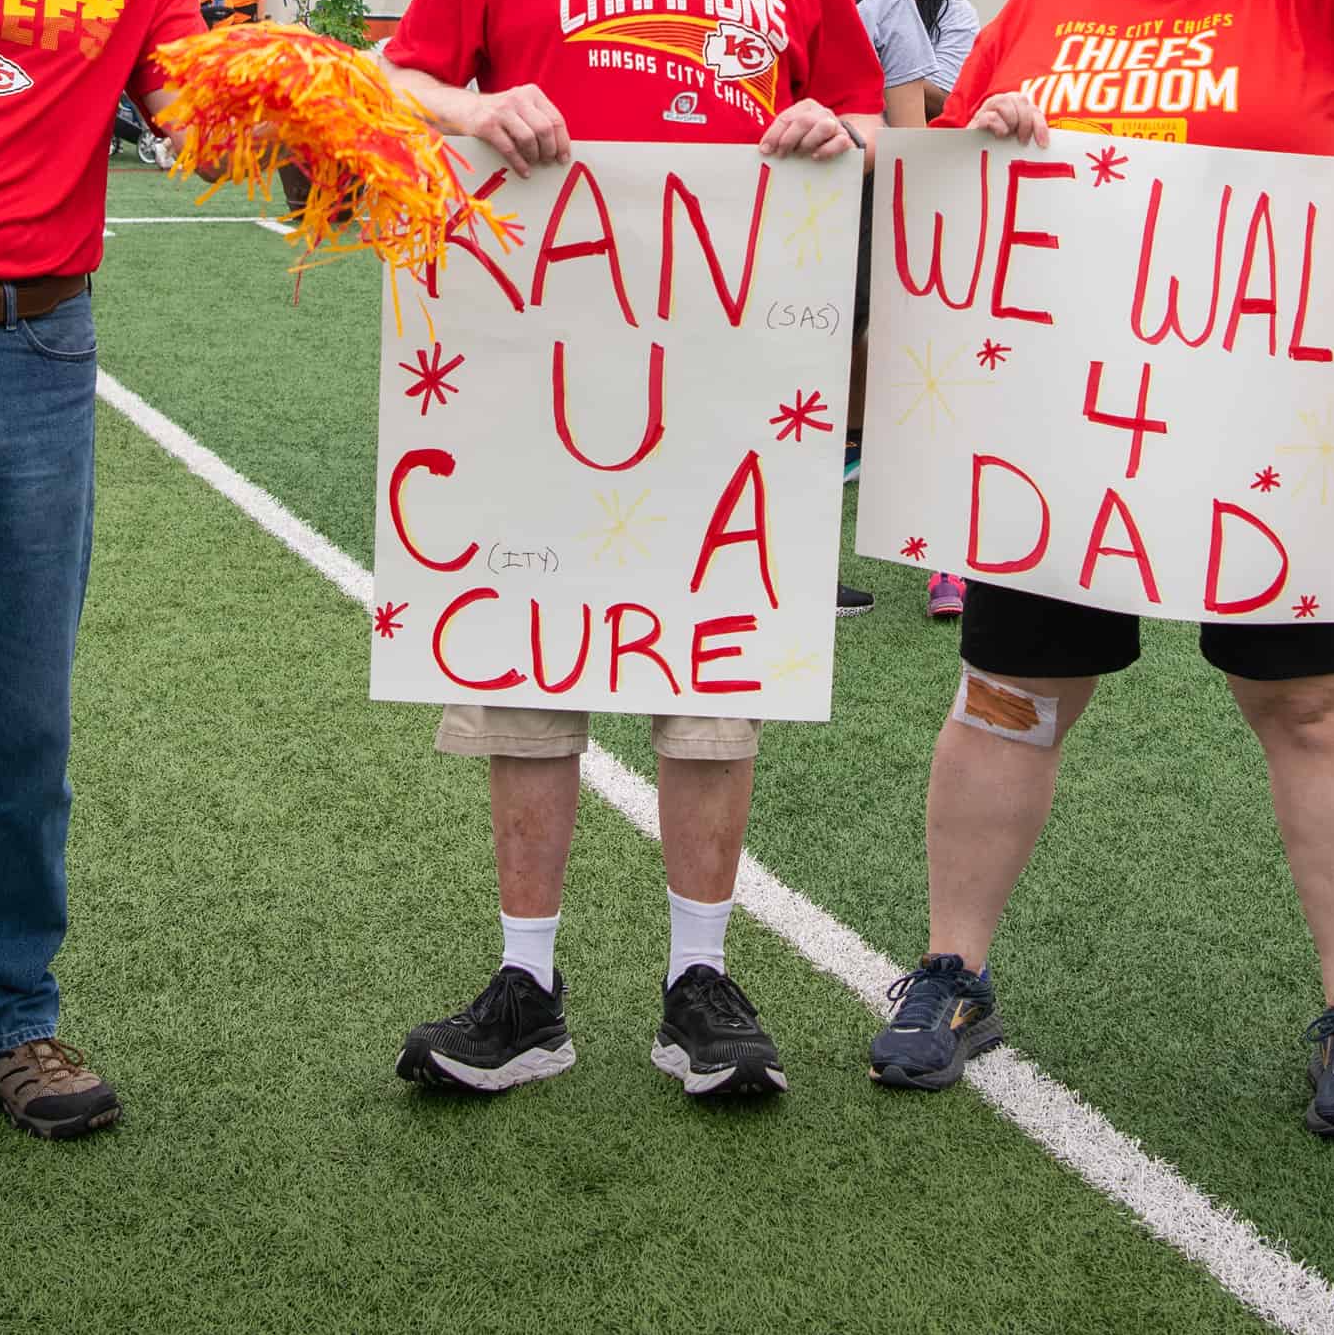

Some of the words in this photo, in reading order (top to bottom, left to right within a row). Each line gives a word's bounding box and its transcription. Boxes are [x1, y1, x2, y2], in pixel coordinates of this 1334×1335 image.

[724, 35, 766, 70] KC
[1051, 29, 1218, 72] CHIEFS
[1055, 21, 1117, 37] KANSAS
[1126, 20, 1164, 38] CITY
[1173, 13, 1234, 34] CHIEFS
[589, 49, 657, 74] KANSAS
[667, 62, 706, 88] CITY
[714, 80, 766, 126] CHIEFS
[1020, 66, 1239, 114] KINGDOM
[891, 149, 1076, 325] WE
[552, 340, 665, 472] U
[1082, 360, 1167, 479] 4
[389, 448, 479, 572] C
[689, 449, 779, 610] A
[966, 452, 1290, 615] DAD
[432, 587, 763, 695] CURE
